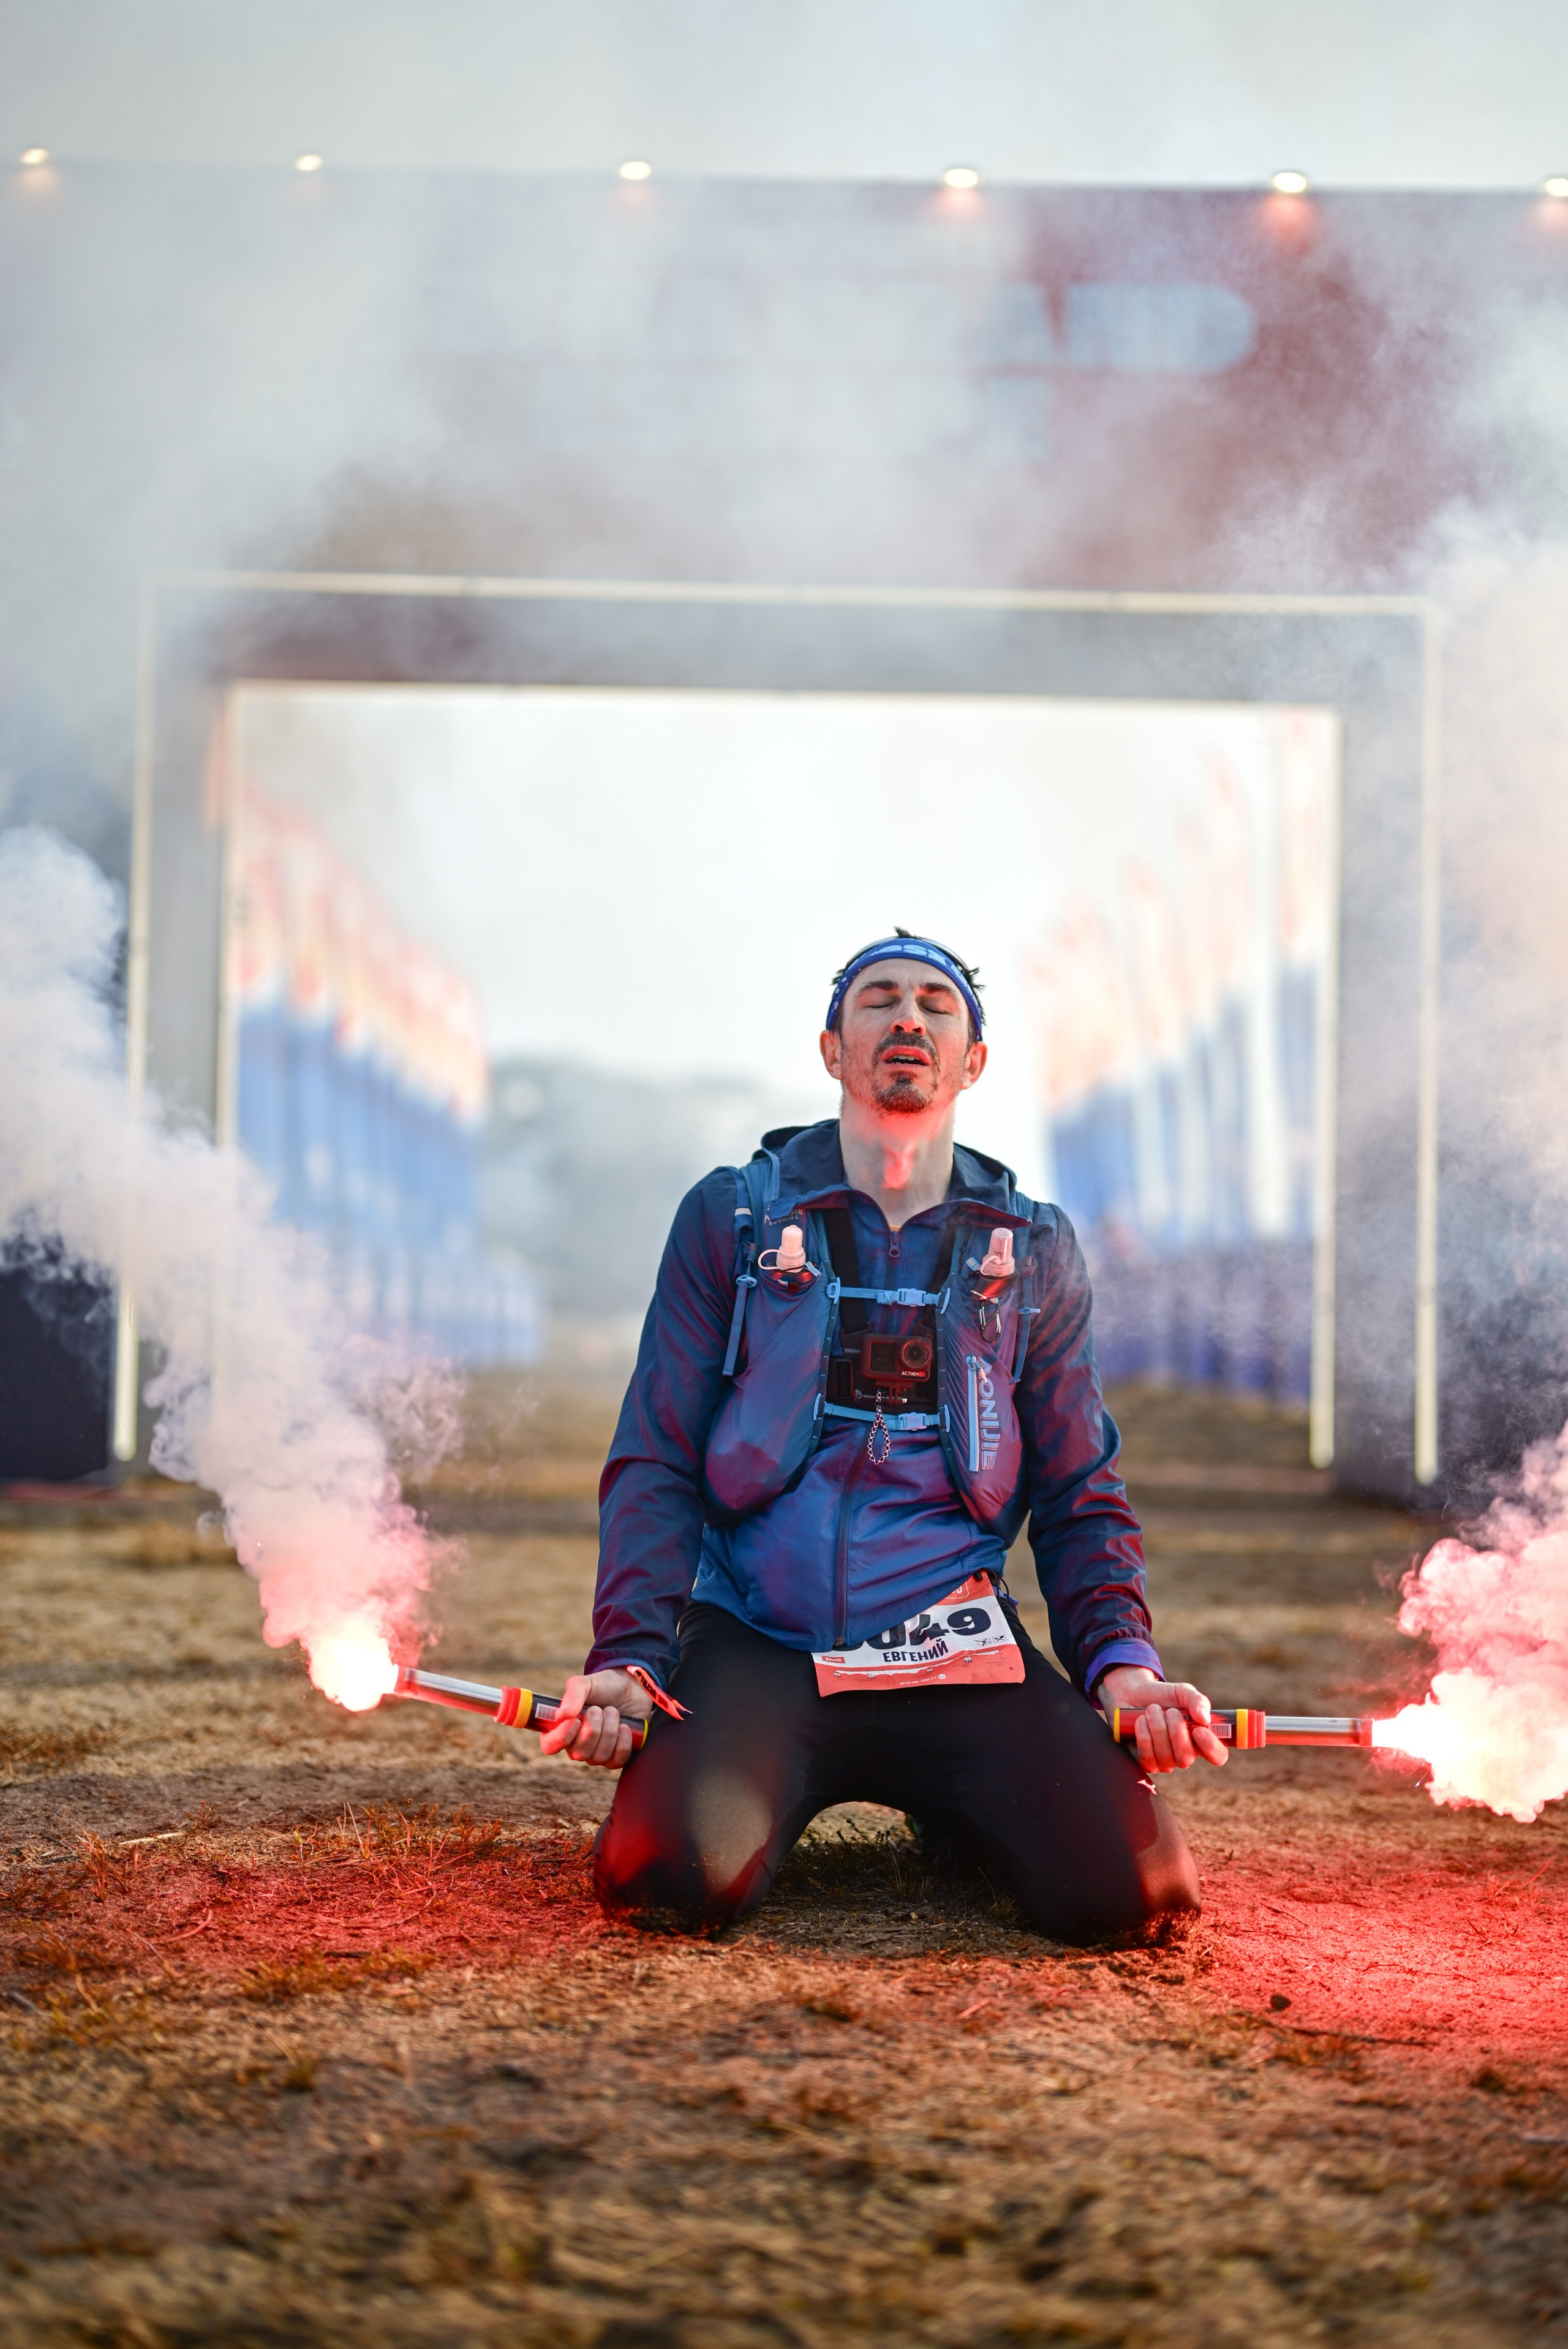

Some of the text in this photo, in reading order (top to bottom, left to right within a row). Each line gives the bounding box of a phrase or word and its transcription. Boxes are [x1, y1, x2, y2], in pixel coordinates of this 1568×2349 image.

[769, 1215, 799, 1226] RUNNING
[832, 1608, 991, 1651] 049
[883, 1638, 948, 1662] ЕВГЕНИЙ
